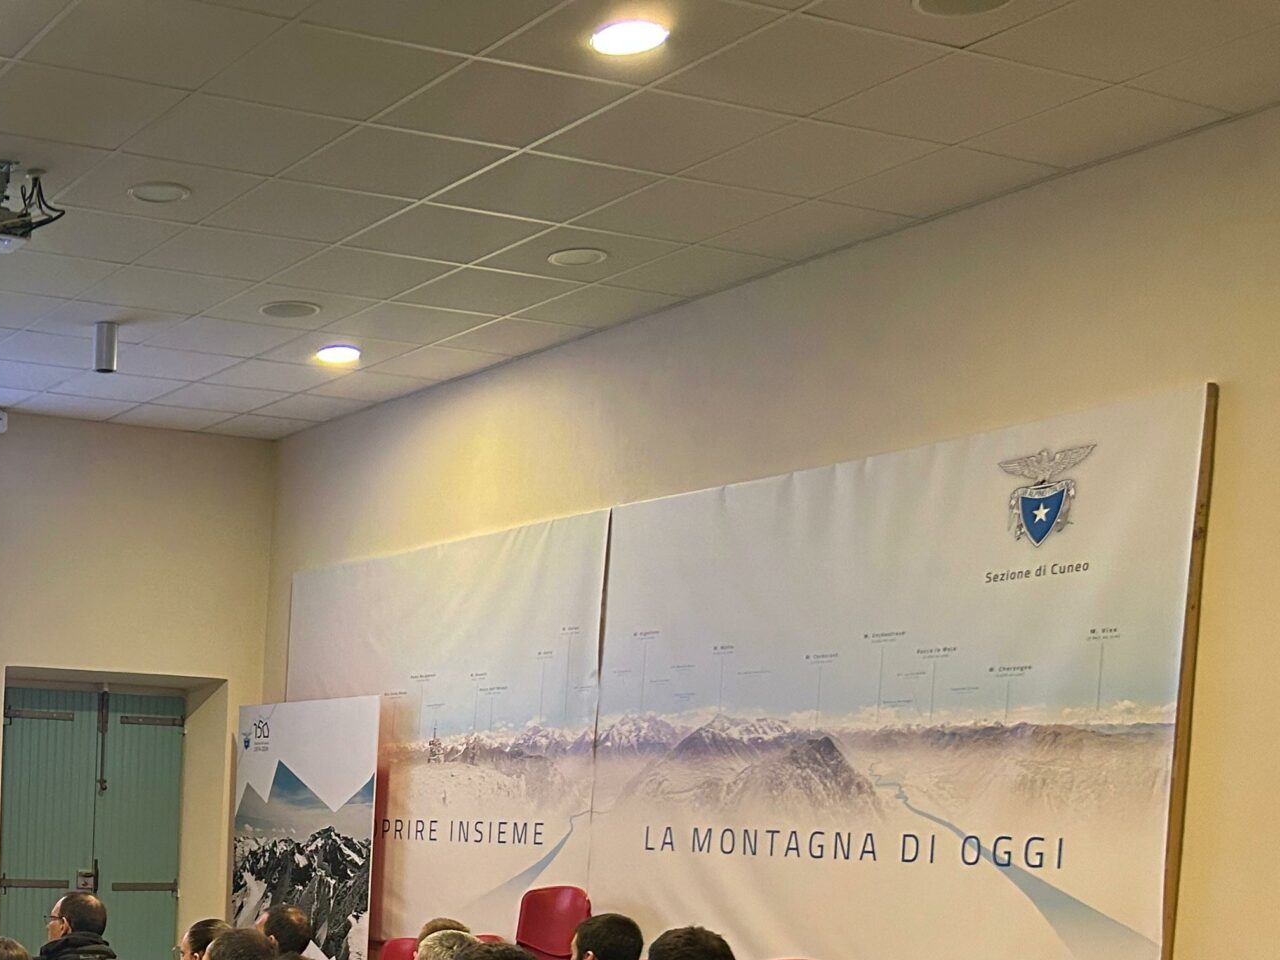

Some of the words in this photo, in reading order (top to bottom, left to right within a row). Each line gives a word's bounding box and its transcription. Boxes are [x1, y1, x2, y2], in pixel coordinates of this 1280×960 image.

[985, 568, 1031, 584] Sezione
[1035, 565, 1046, 577] di
[1051, 561, 1090, 575] Cuneo
[374, 819, 438, 841] PRIRE
[449, 820, 545, 845] INSIEME
[644, 825, 675, 852] LA
[691, 827, 877, 862] MONTAGNA
[900, 833, 936, 864] DI
[961, 834, 1064, 869] OGGI
